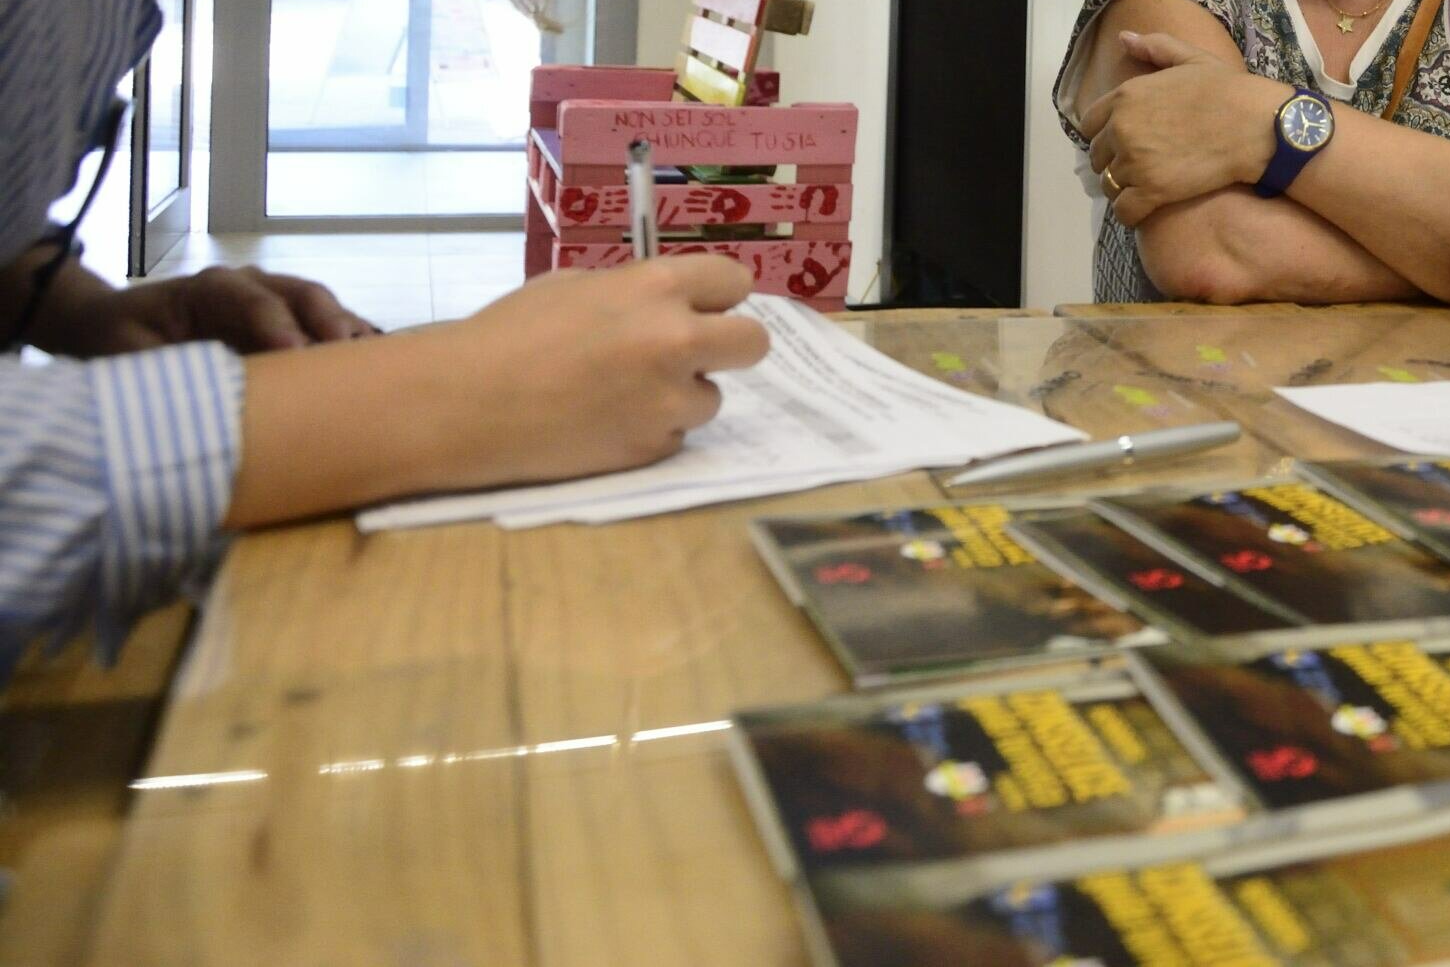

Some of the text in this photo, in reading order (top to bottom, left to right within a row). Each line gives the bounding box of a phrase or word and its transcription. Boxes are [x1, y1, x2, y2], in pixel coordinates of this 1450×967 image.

[615, 111, 655, 128] NON
[662, 110, 692, 127] SEI
[752, 132, 777, 150] TU
[782, 132, 817, 150] SIA
